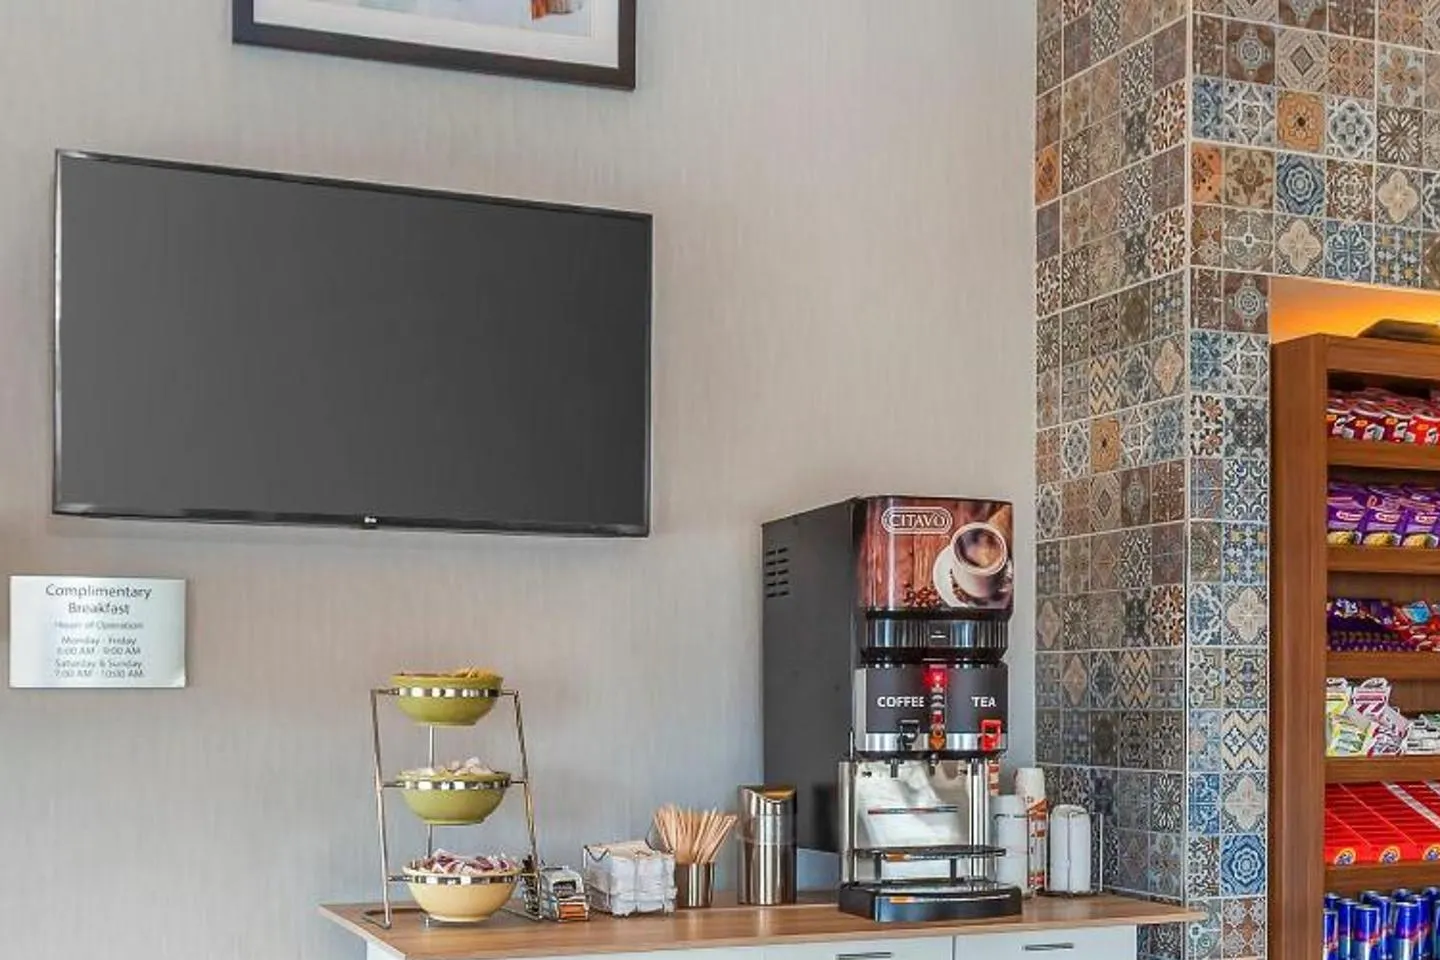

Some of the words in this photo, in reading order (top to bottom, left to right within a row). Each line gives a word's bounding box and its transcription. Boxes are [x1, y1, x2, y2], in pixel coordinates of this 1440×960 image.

[889, 513, 946, 529] CITAVO
[45, 583, 152, 600] Complimentary
[68, 602, 131, 615] Breakfast
[107, 660, 142, 669] Sunday
[877, 696, 925, 708] COFFEE
[971, 696, 997, 708] TEA
